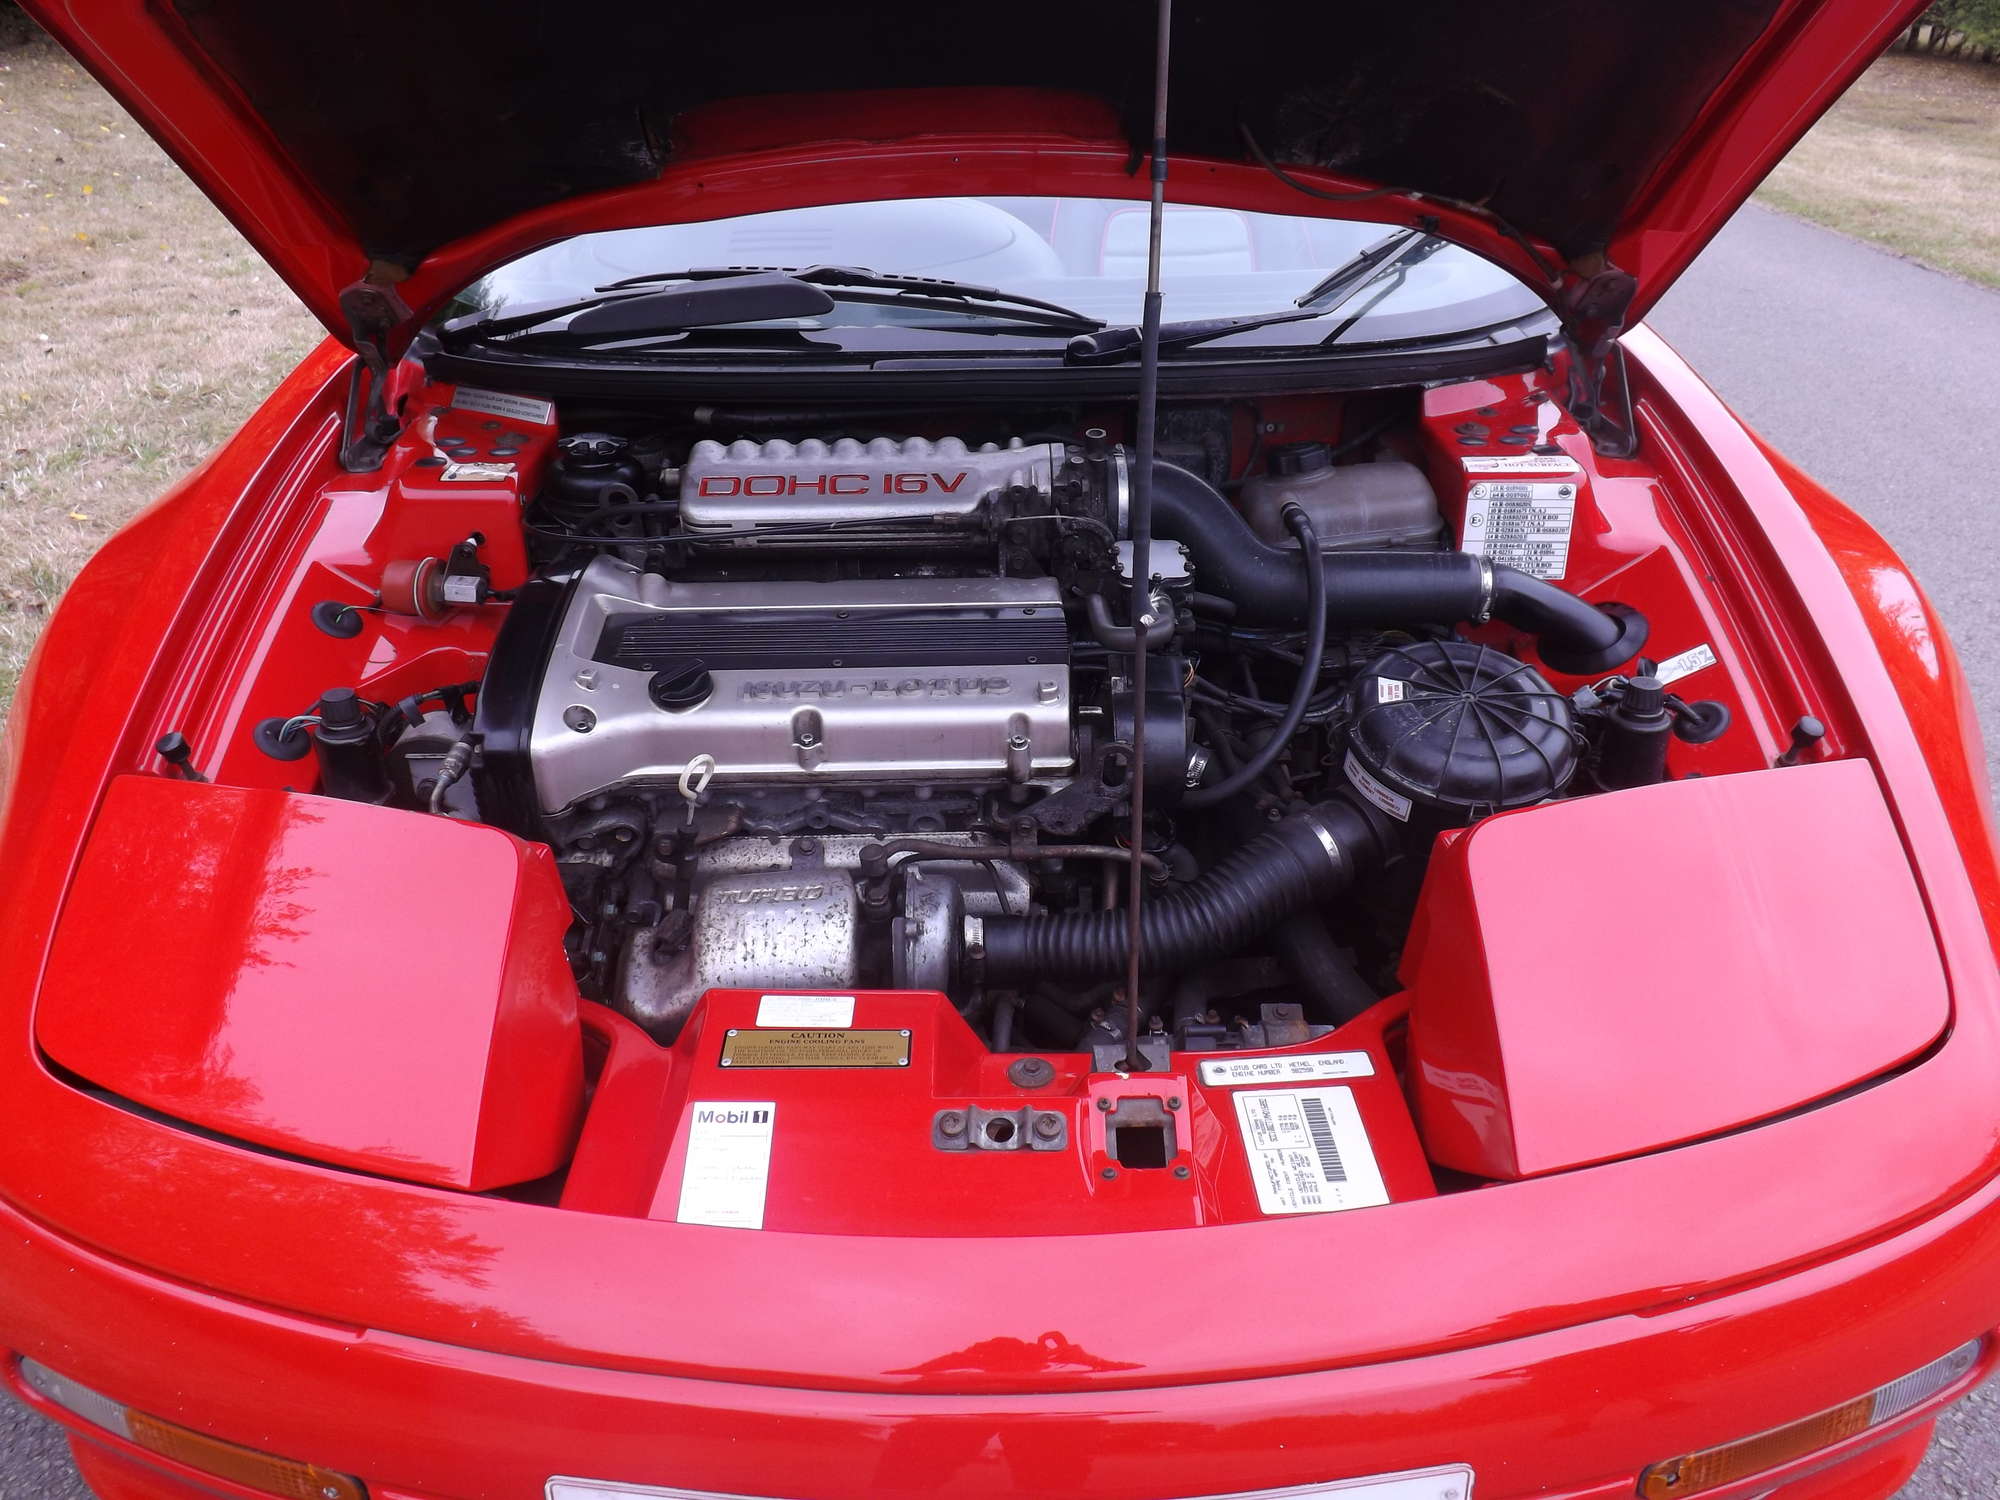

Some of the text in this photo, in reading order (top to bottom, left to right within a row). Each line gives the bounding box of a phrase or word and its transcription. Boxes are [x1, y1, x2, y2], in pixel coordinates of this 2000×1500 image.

[698, 472, 967, 497] DOHC 16V
[717, 885, 825, 904] TURBO
[698, 1110, 749, 1123] Mobil
